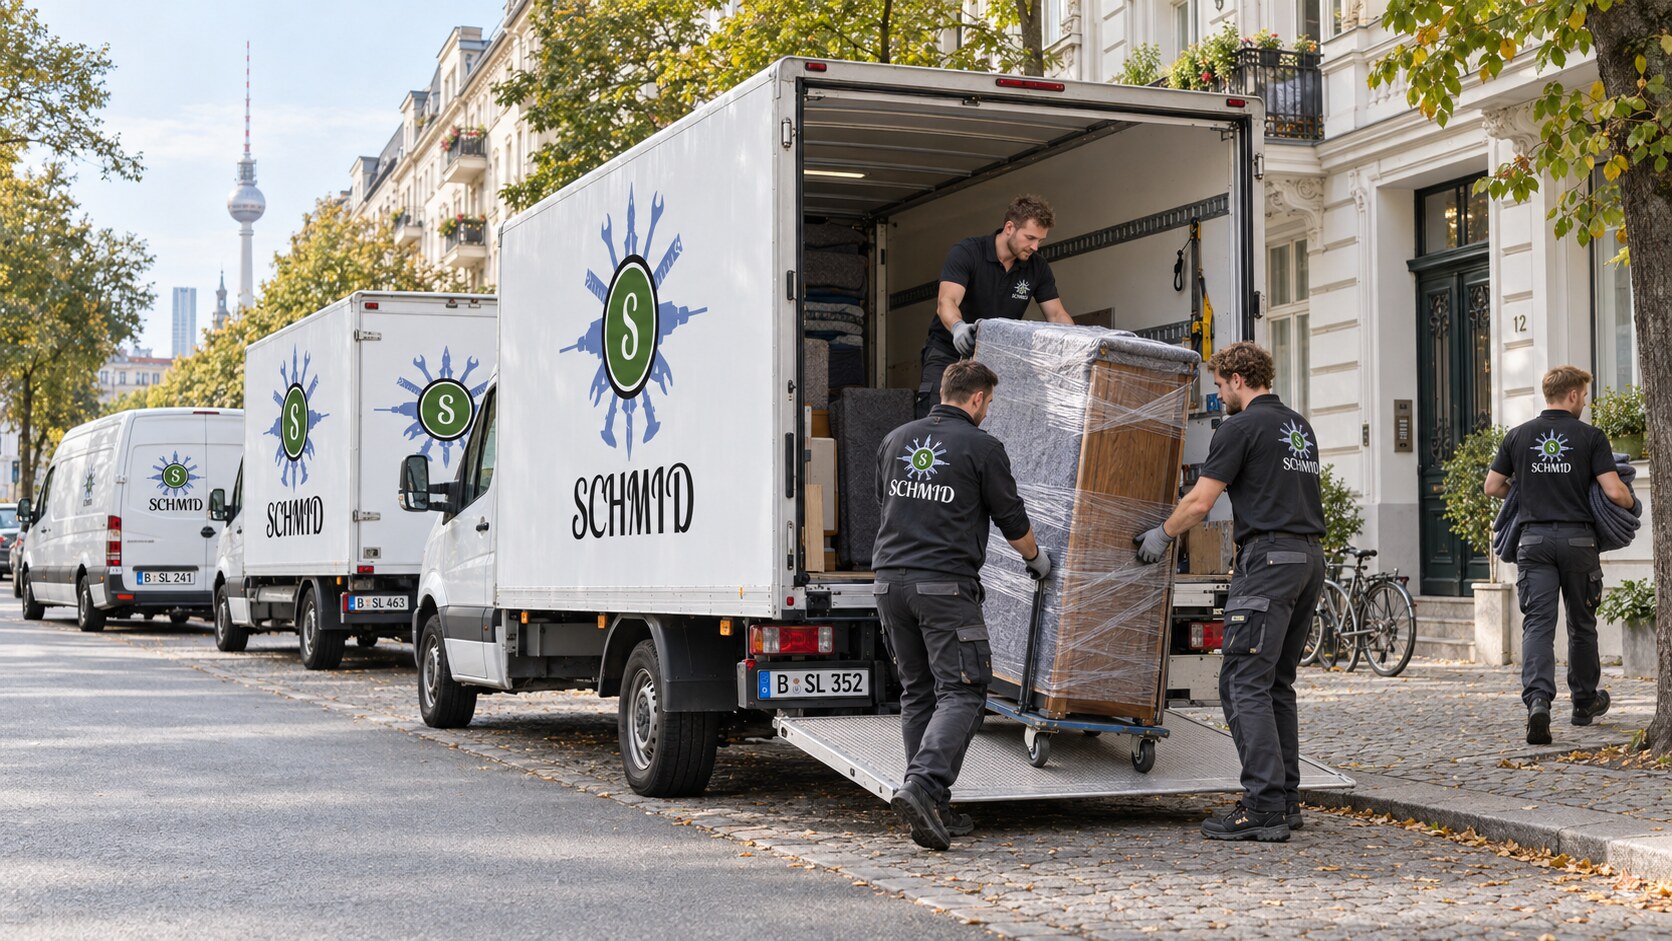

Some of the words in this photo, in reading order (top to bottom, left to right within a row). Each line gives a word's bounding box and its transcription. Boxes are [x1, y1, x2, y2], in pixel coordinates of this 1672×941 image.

[621, 291, 639, 361] S
[1513, 314, 1527, 333] 12
[437, 394, 455, 425] S
[290, 402, 299, 440] S
[1294, 435, 1302, 448] S
[1548, 442, 1556, 453] S
[918, 452, 928, 467] S
[1531, 462, 1572, 473] SCHMID
[171, 469, 181, 483] S
[888, 479, 955, 504] SCHMID
[149, 498, 203, 511] SCHMID
[571, 462, 695, 541] SCHMID
[266, 495, 324, 538] SCHMID
[144, 572, 151, 583] B
[158, 572, 171, 583] SL
[173, 572, 192, 583] 241
[357, 597, 364, 609] B
[372, 597, 384, 609] SL
[386, 597, 405, 608] 463
[777, 674, 789, 694] B
[804, 673, 826, 693] SL
[831, 672, 863, 693] 352
